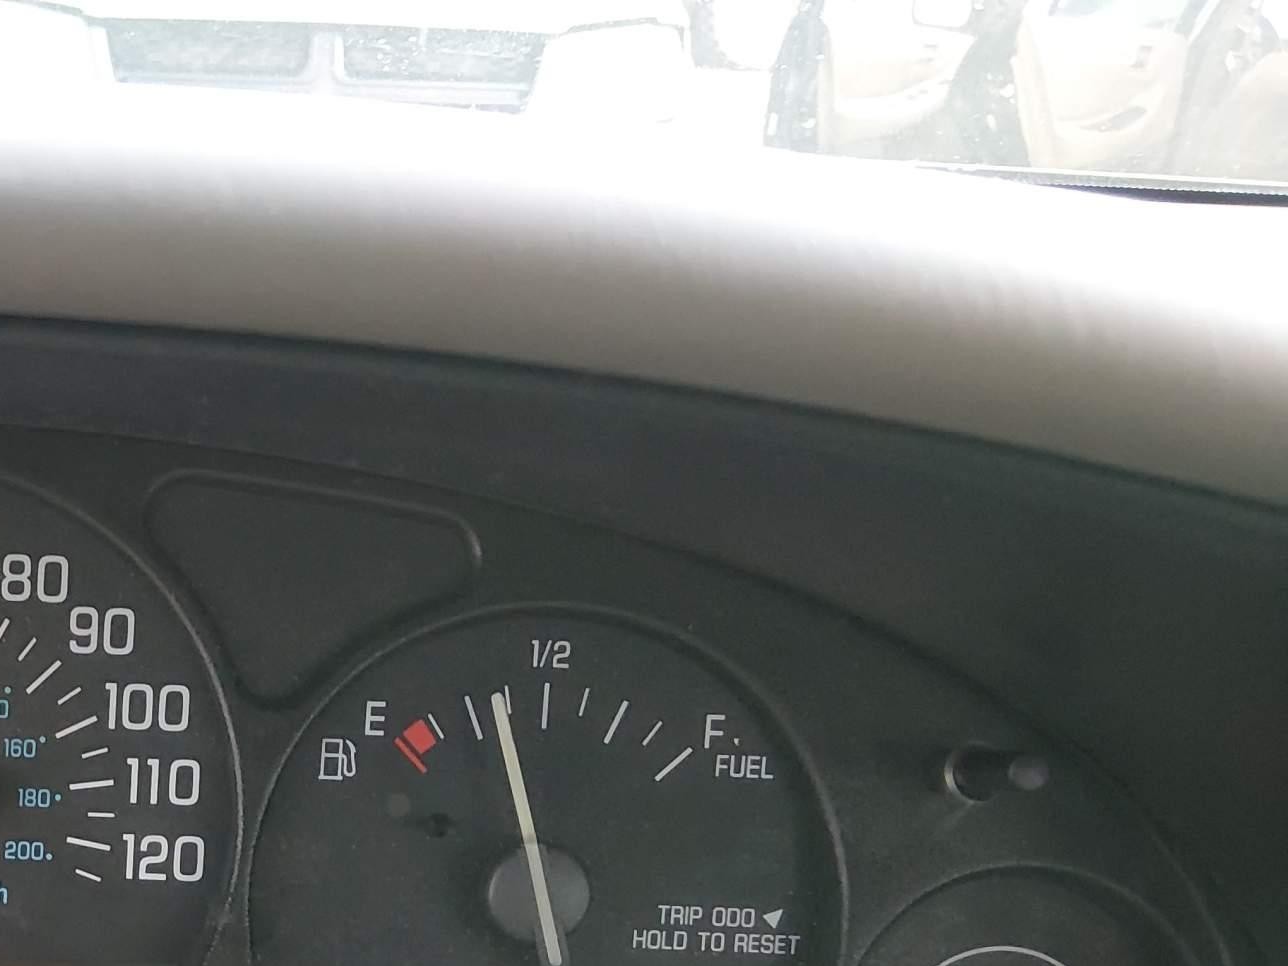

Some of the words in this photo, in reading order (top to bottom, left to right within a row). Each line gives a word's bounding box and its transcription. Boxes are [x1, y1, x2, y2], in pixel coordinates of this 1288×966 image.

[1, 553, 69, 604] 80
[69, 606, 136, 655] 90
[531, 639, 571, 669] 1/2
[105, 682, 191, 732] 100
[364, 701, 387, 736] E
[704, 714, 726, 749] F
[4, 738, 36, 758] 160
[127, 757, 200, 806] 110
[715, 755, 774, 779] FUEL
[18, 788, 51, 808] 180
[4, 840, 46, 861] 200
[123, 833, 205, 882] 120
[658, 905, 703, 926] TRIP
[712, 907, 755, 928] ODO
[632, 930, 687, 951] HOLD
[698, 932, 725, 953] TO
[734, 934, 800, 955] RESET
